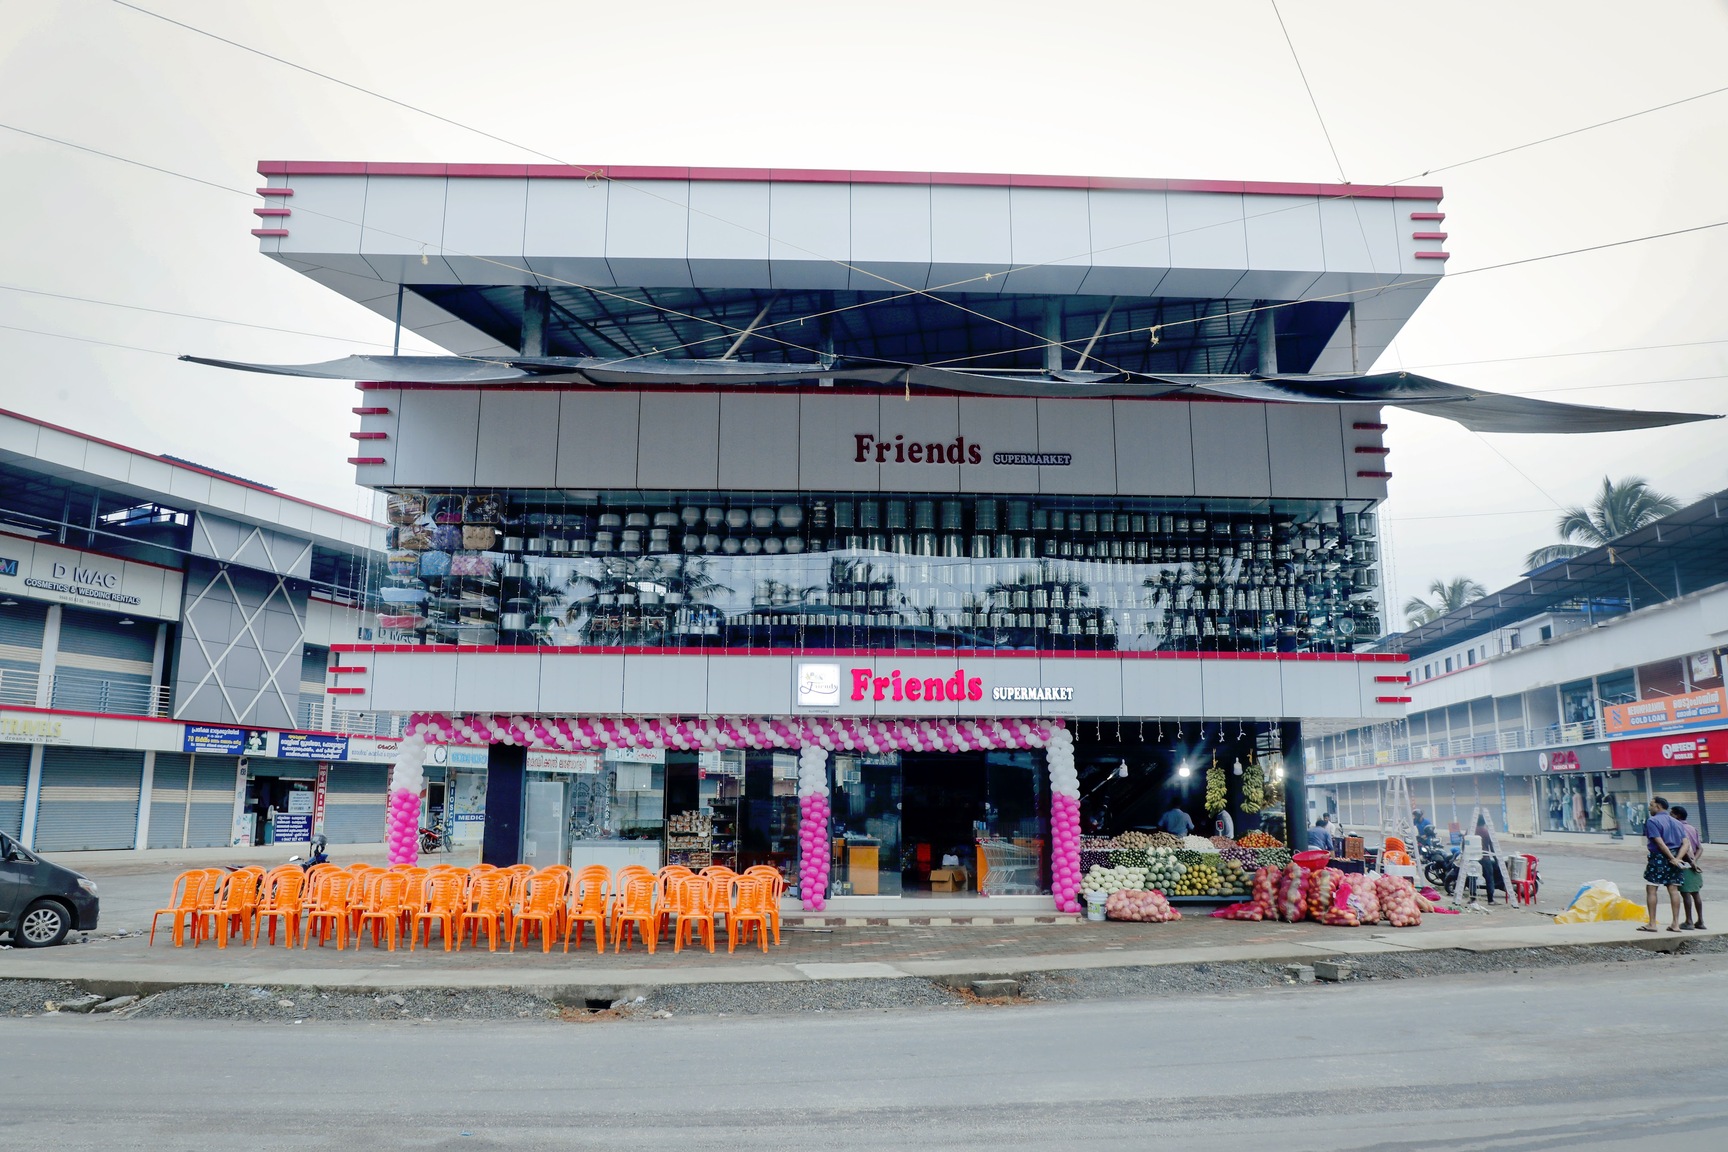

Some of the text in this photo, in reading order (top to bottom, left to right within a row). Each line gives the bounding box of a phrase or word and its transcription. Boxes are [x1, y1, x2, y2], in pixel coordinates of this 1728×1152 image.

[854, 433, 1071, 466] Friends SUPERMARKET
[53, 562, 117, 589] D MAC
[25, 578, 69, 593] COSMETICS
[69, 586, 76, 594] &
[77, 587, 111, 601] WEDDING
[111, 593, 141, 605] RENTALS
[850, 668, 1073, 701] Friends SUPERMARKET
[1, 718, 62, 737] TRAVELS
[1630, 716, 1648, 725] GOLD
[1649, 713, 1666, 723] LOAN
[1551, 750, 1579, 765] ZOYA
[447, 781, 455, 835] BIOSCAN
